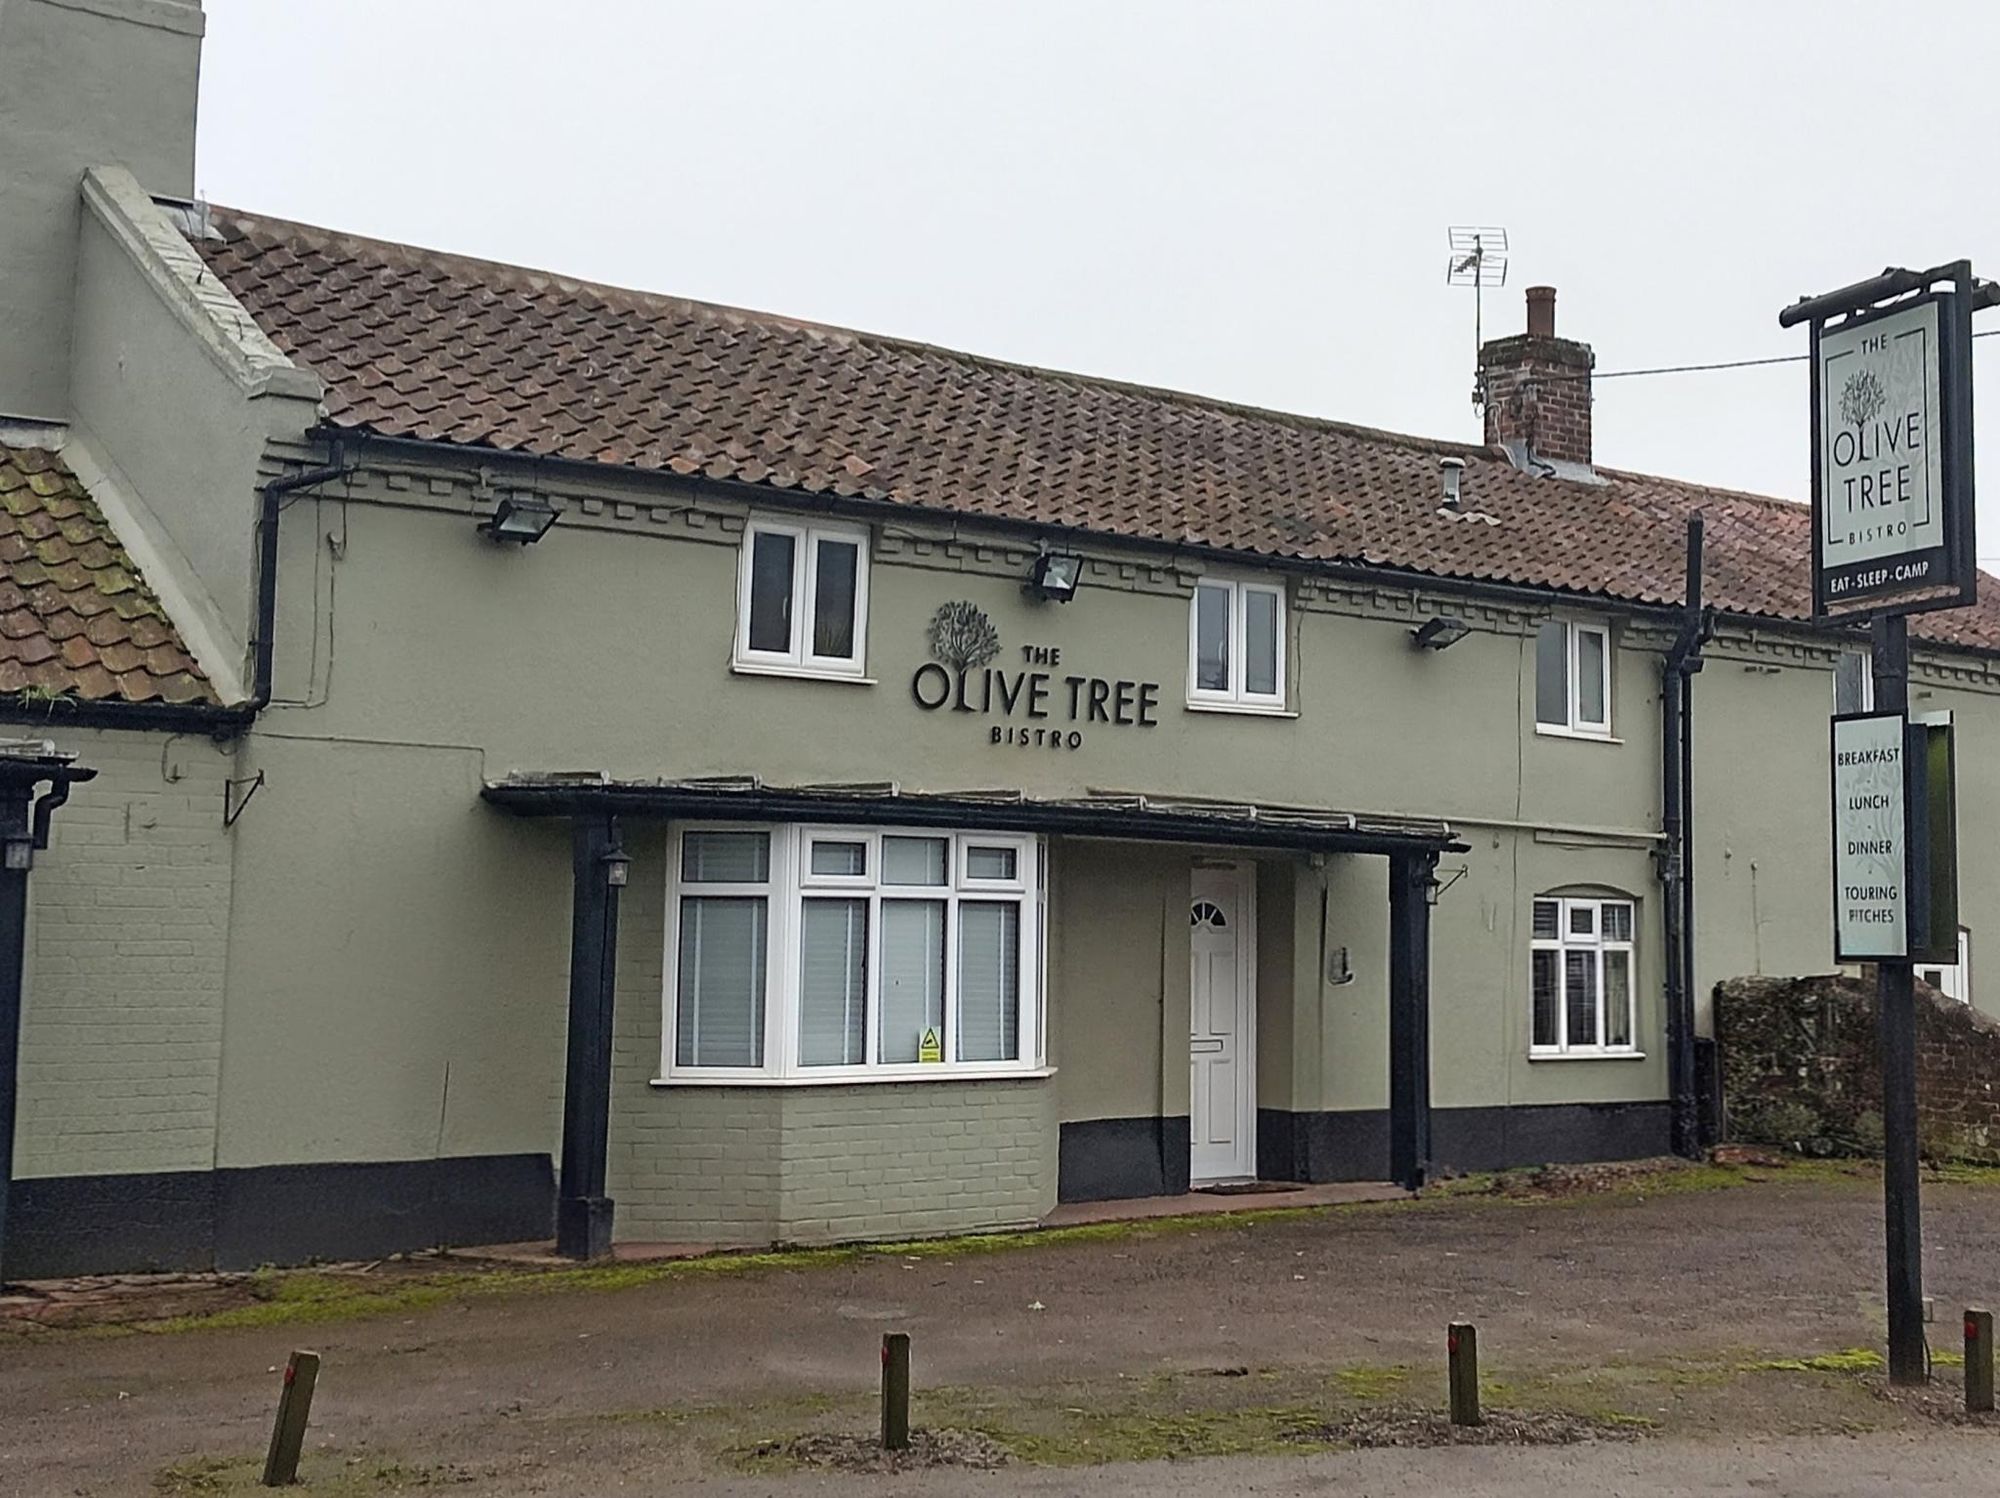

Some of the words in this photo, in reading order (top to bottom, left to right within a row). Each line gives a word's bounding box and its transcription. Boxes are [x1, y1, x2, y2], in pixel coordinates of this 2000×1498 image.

[1861, 334, 1888, 354] THE
[1833, 412, 1920, 467] OLIVE
[1844, 465, 1911, 513] TREE
[1849, 521, 1907, 545] BISTRO
[1022, 645, 1060, 666] THE
[912, 663, 1050, 718] OLIVE
[1065, 676, 1159, 726] TREE
[991, 726, 1082, 749] BISTRO
[1837, 748, 1900, 766] BREAKFAST
[1849, 794, 1889, 810] LUNCH
[1848, 840, 1892, 856] DINNER
[1845, 886, 1897, 900] TOURING
[1849, 908, 1894, 923] PITCHES
